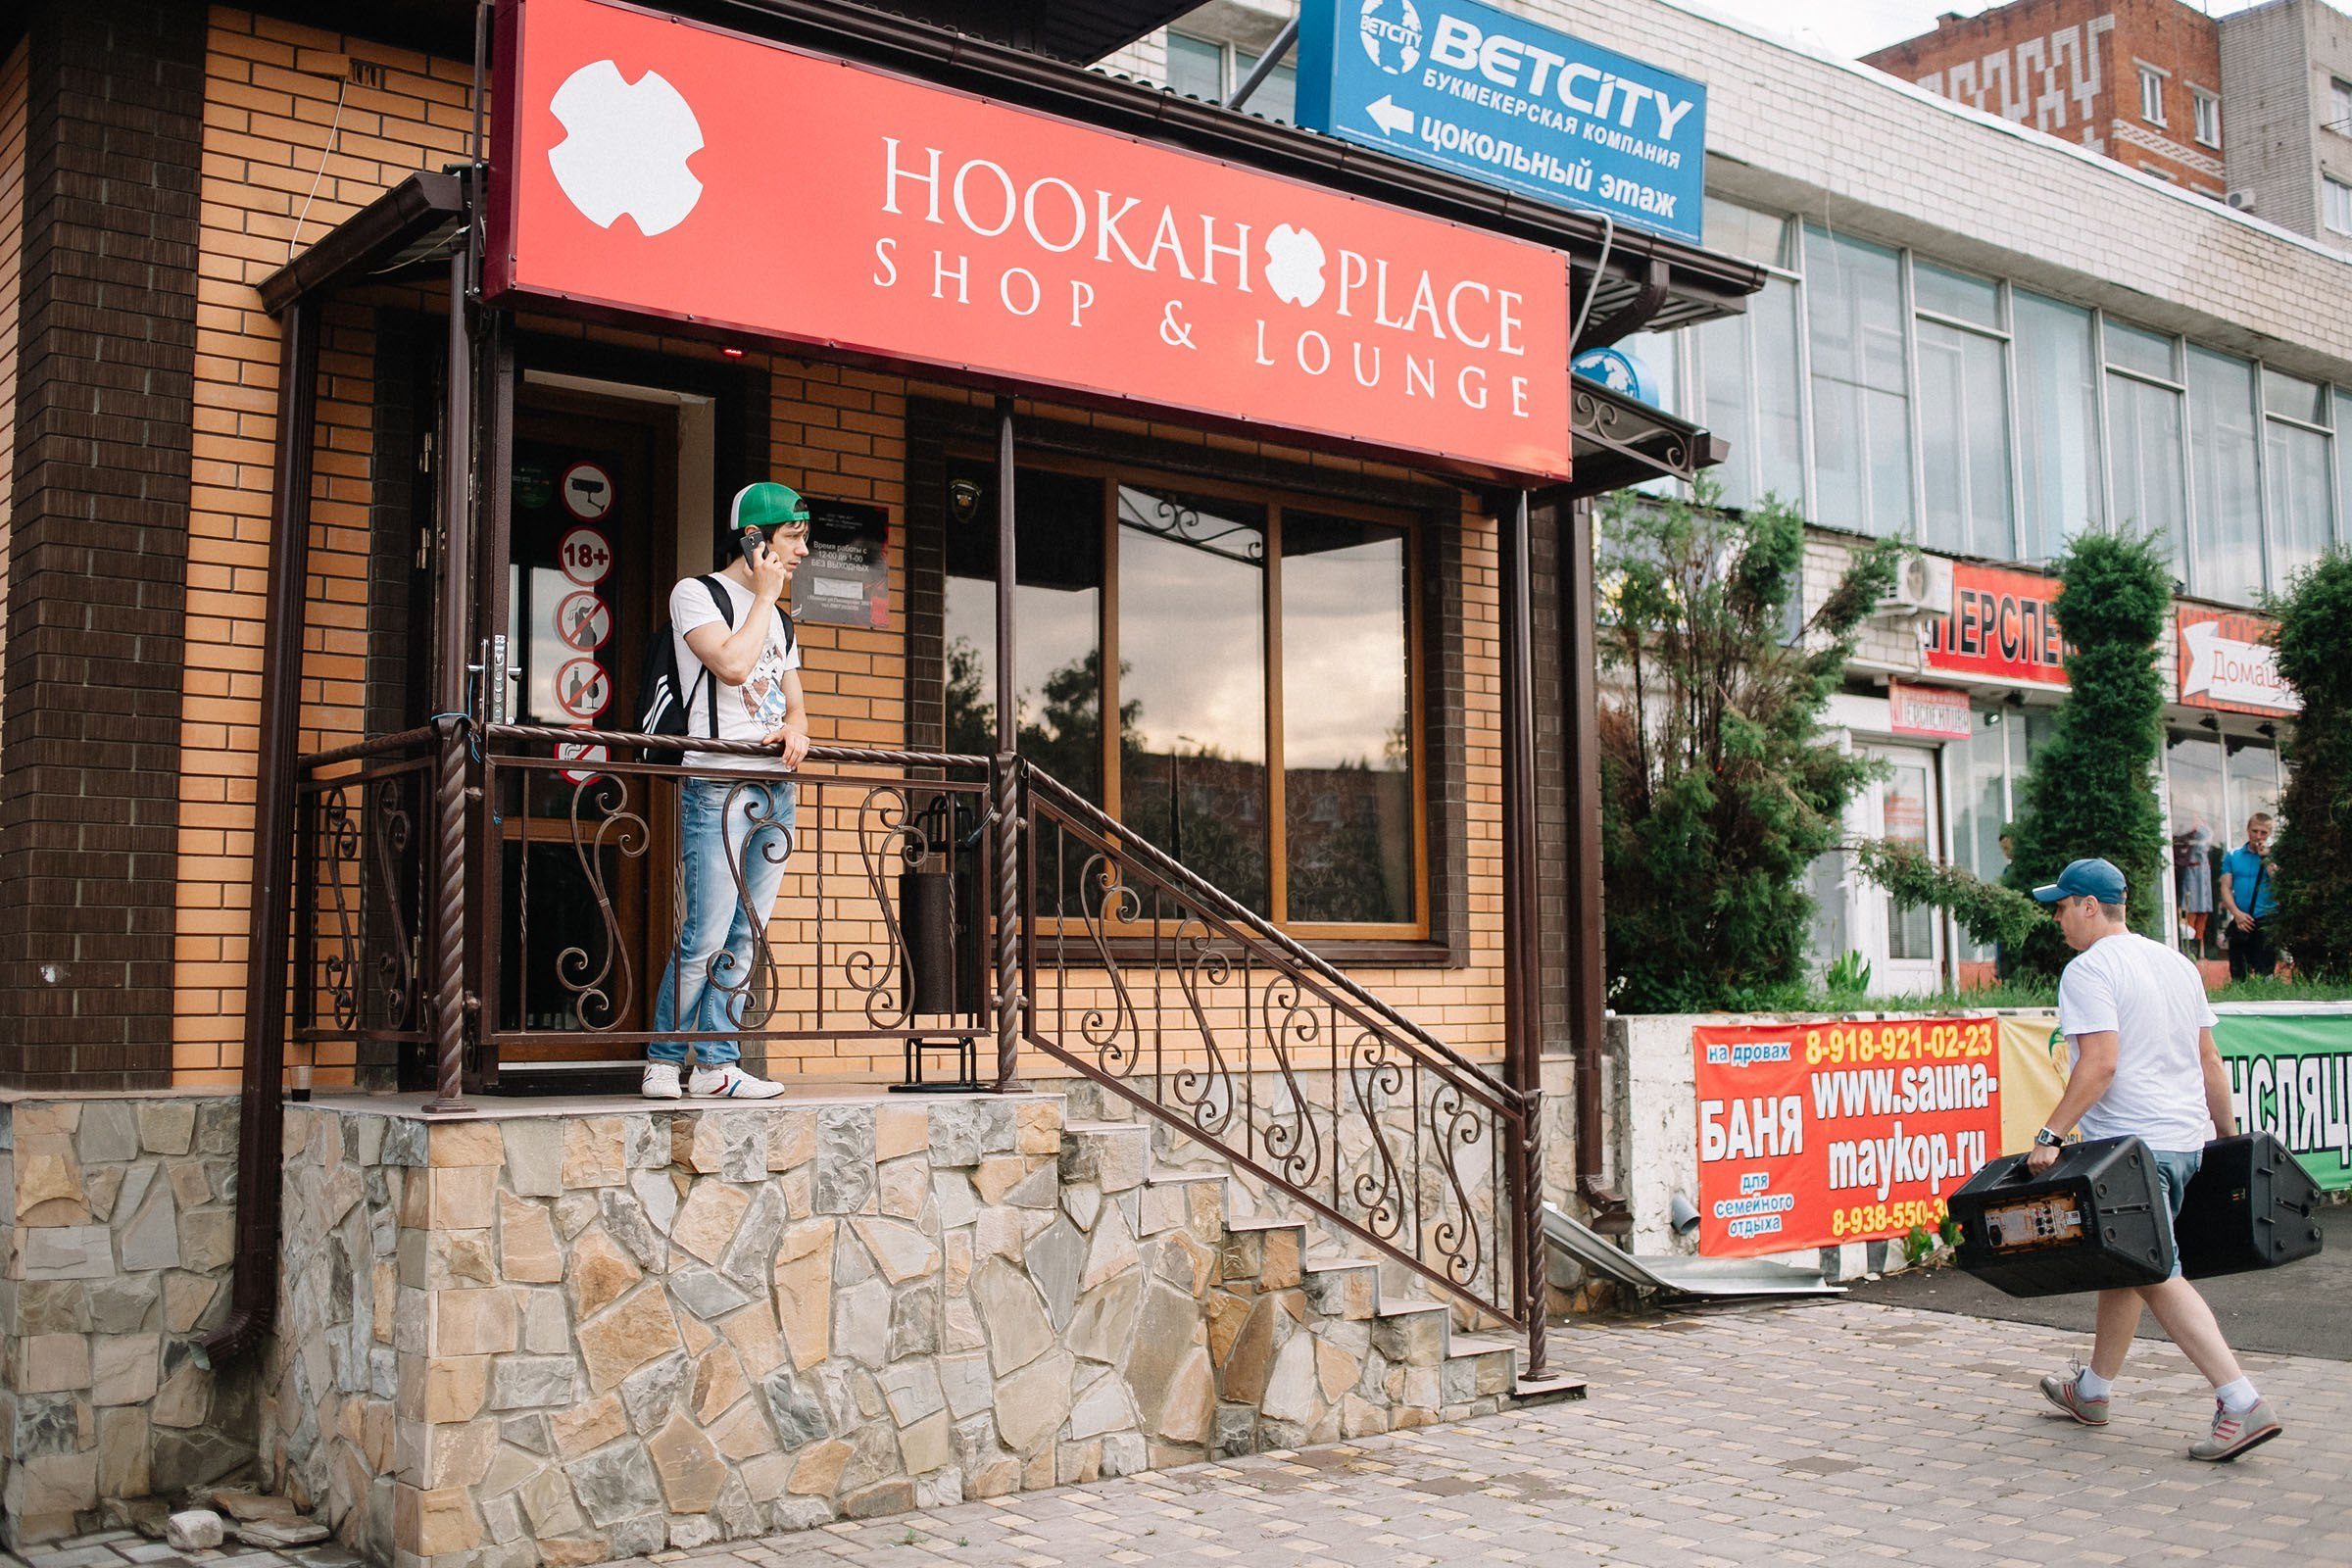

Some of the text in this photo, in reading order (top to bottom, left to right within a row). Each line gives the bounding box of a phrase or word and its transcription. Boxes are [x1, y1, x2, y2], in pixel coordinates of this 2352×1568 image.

[1429, 14, 1694, 140] BETCITY
[1422, 69, 1577, 134] БУКМЕКЕРСКАЯ
[1583, 122, 1681, 170] КОМПАНИЯ
[1598, 173, 1678, 219] этаж
[881, 136, 1526, 356] HOOKAH PLACE
[873, 237, 1529, 417] SHOP & LOUNGE
[564, 543, 609, 568] 18+
[811, 559, 869, 572] БЕЗ ВЫХОДНЫХ
[813, 541, 836, 551] Время
[837, 544, 861, 554] работы
[818, 551, 863, 563] 12-00 до 1-00
[1707, 1042, 1792, 1067] на дровах
[1805, 1023, 1993, 1066] 8-918-921-02-23
[1811, 1062, 1998, 1120] www.sauna-
[2223, 1053, 2352, 1171] НСЛЯЦ
[1700, 1096, 1804, 1162] БАНЯ
[1829, 1120, 1986, 1202] maykop.ru
[1740, 1173, 1769, 1195] для
[1714, 1195, 1794, 1219] семейного
[1728, 1215, 1782, 1238] отдыха
[1833, 1198, 1949, 1238] 8-938-550-3
